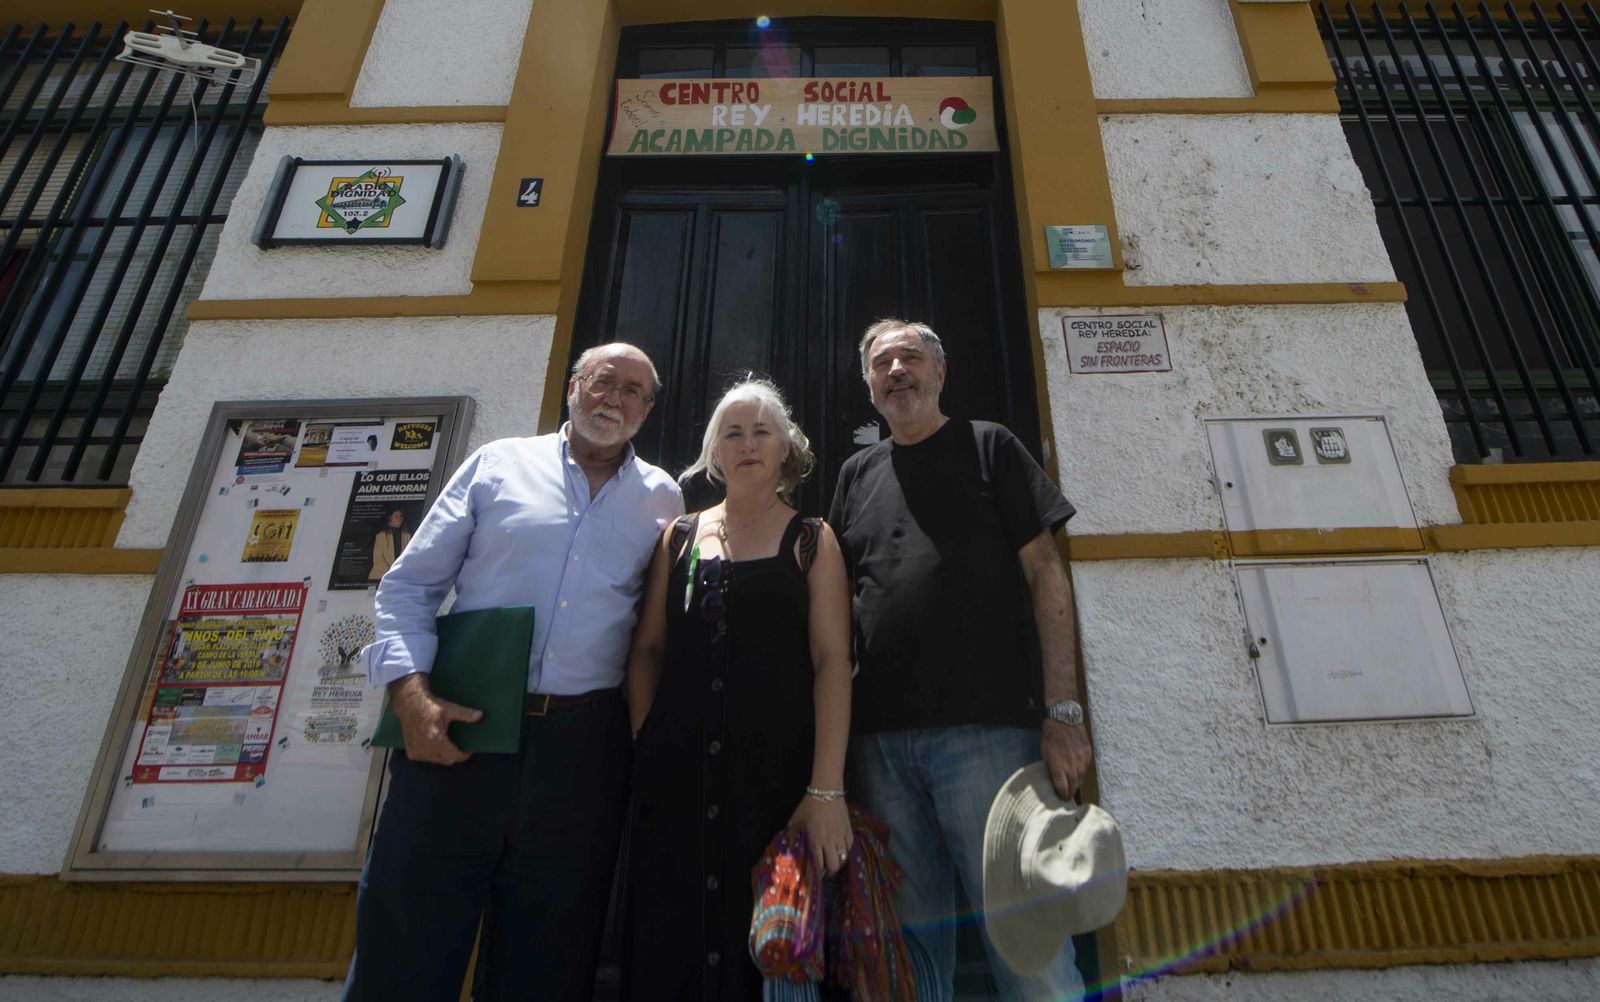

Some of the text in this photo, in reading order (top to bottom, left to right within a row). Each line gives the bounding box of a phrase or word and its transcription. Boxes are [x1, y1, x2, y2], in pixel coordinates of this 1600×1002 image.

[659, 82, 760, 105] CENTRO
[711, 103, 771, 127] REY
[627, 127, 796, 153] ACAMPADA
[344, 182, 387, 191] RADIO
[331, 190, 397, 199] DIGNIDAD
[520, 181, 538, 205] 4
[1070, 320, 1156, 330] CENTRO SOCIAL
[1079, 329, 1152, 339] REY HEREDIA:
[1096, 341, 1141, 354] ESPACIO
[1080, 354, 1161, 368] SIN FRONTERAS
[397, 423, 433, 432] REFUGEES
[394, 440, 429, 449] WELCOME
[360, 472, 429, 482] LO QUE ELLOS
[358, 484, 428, 494] AÚN IGNORAN
[201, 590, 232, 609] GRAN
[233, 589, 302, 609] CARACOLADA
[226, 630, 249, 640] DEL
[208, 661, 230, 669] JUNIO
[243, 660, 261, 668] 2019
[185, 671, 211, 679] PARTIR
[224, 671, 237, 679] LAS
